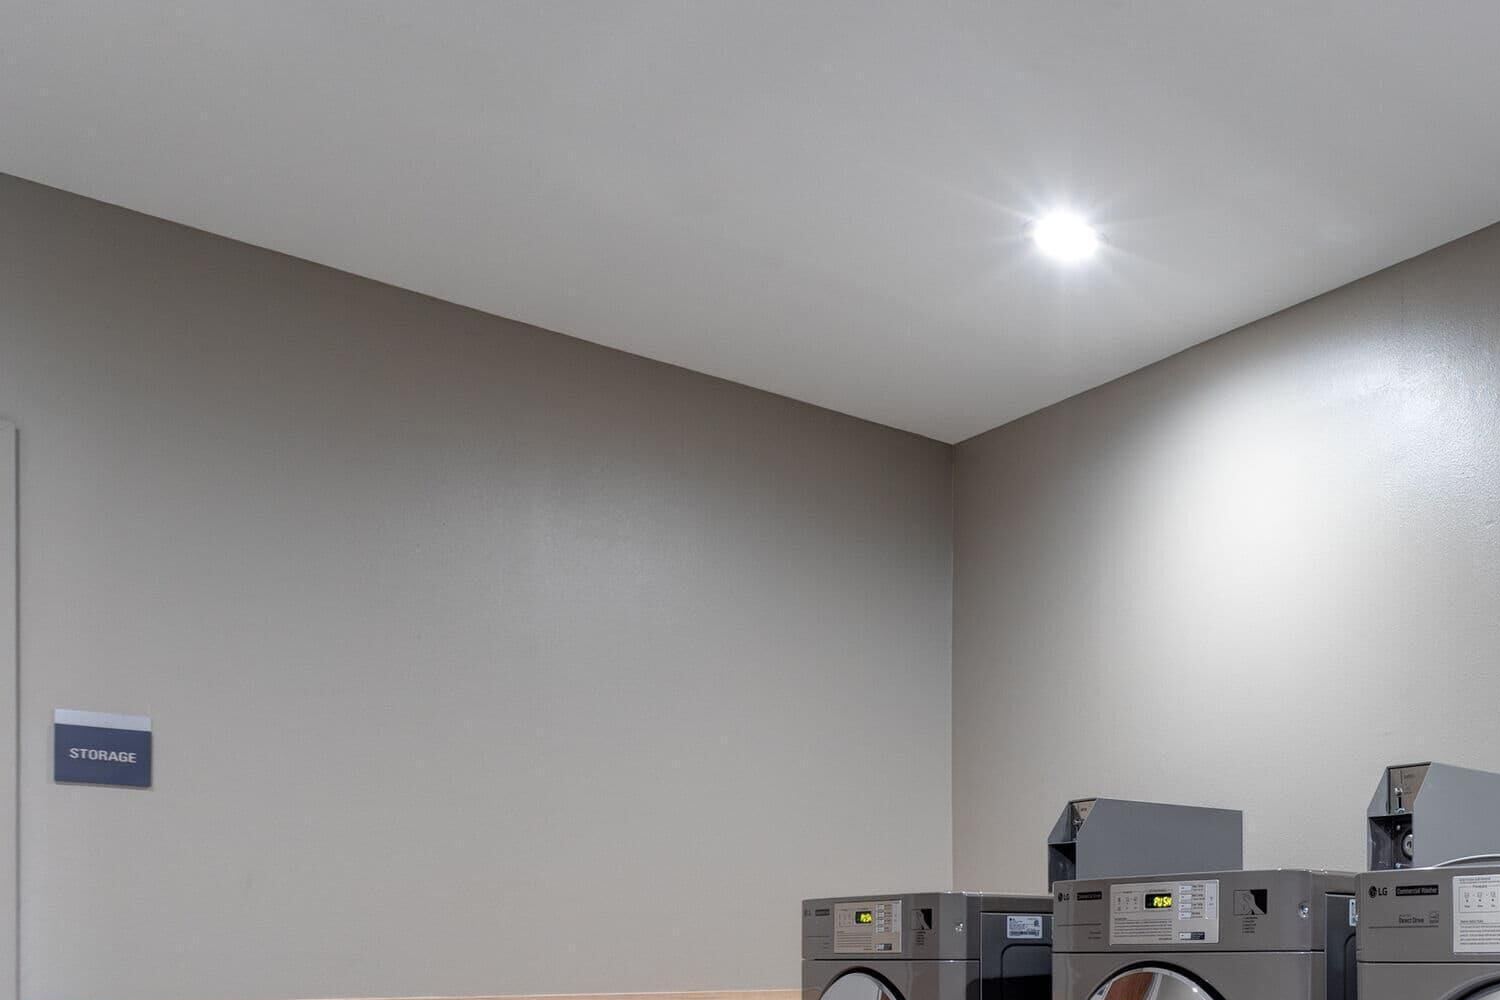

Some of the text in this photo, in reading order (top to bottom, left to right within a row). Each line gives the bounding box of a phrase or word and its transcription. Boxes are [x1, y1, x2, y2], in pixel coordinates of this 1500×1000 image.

[69, 747, 137, 763] STORAGE
[1378, 887, 1388, 896] LG
[1153, 896, 1172, 907] PUSH
